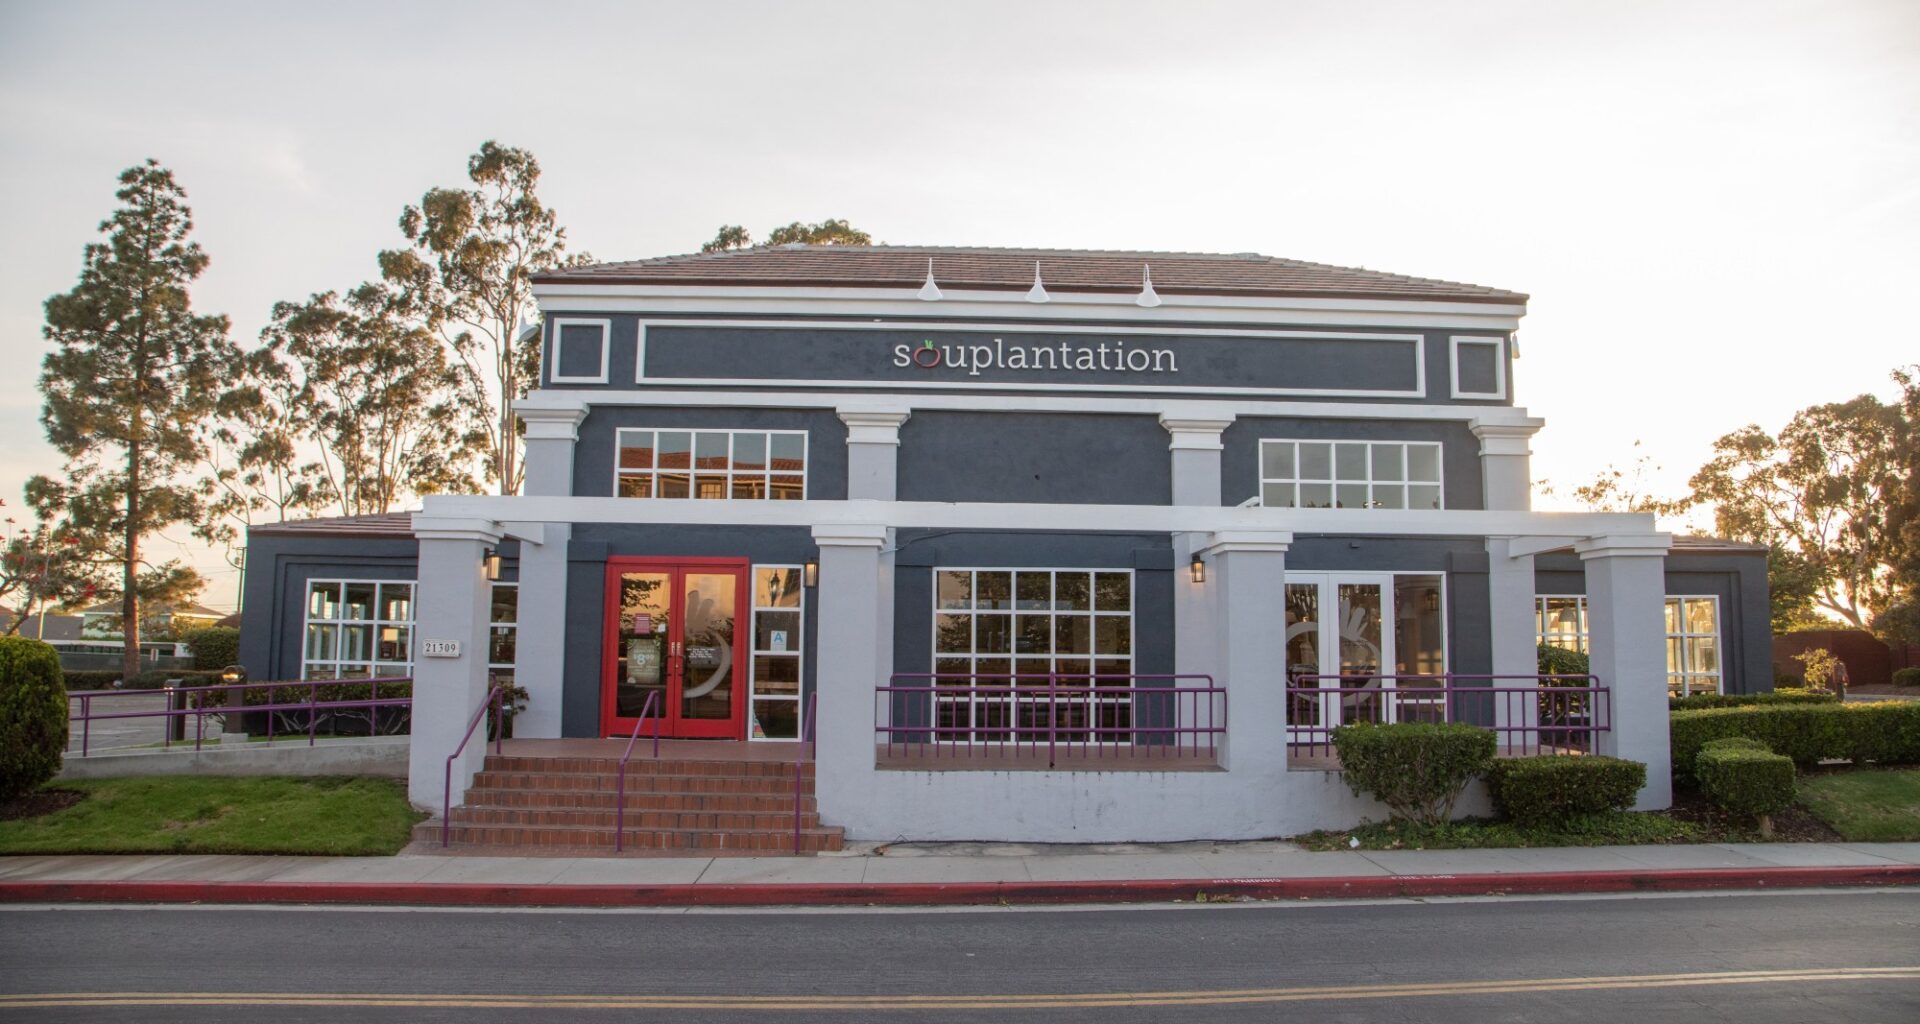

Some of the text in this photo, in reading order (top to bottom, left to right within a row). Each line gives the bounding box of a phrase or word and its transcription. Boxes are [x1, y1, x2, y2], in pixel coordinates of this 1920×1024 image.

[893, 339, 1178, 376] souplantation
[774, 632, 783, 642] A
[425, 642, 456, 653] 21309
